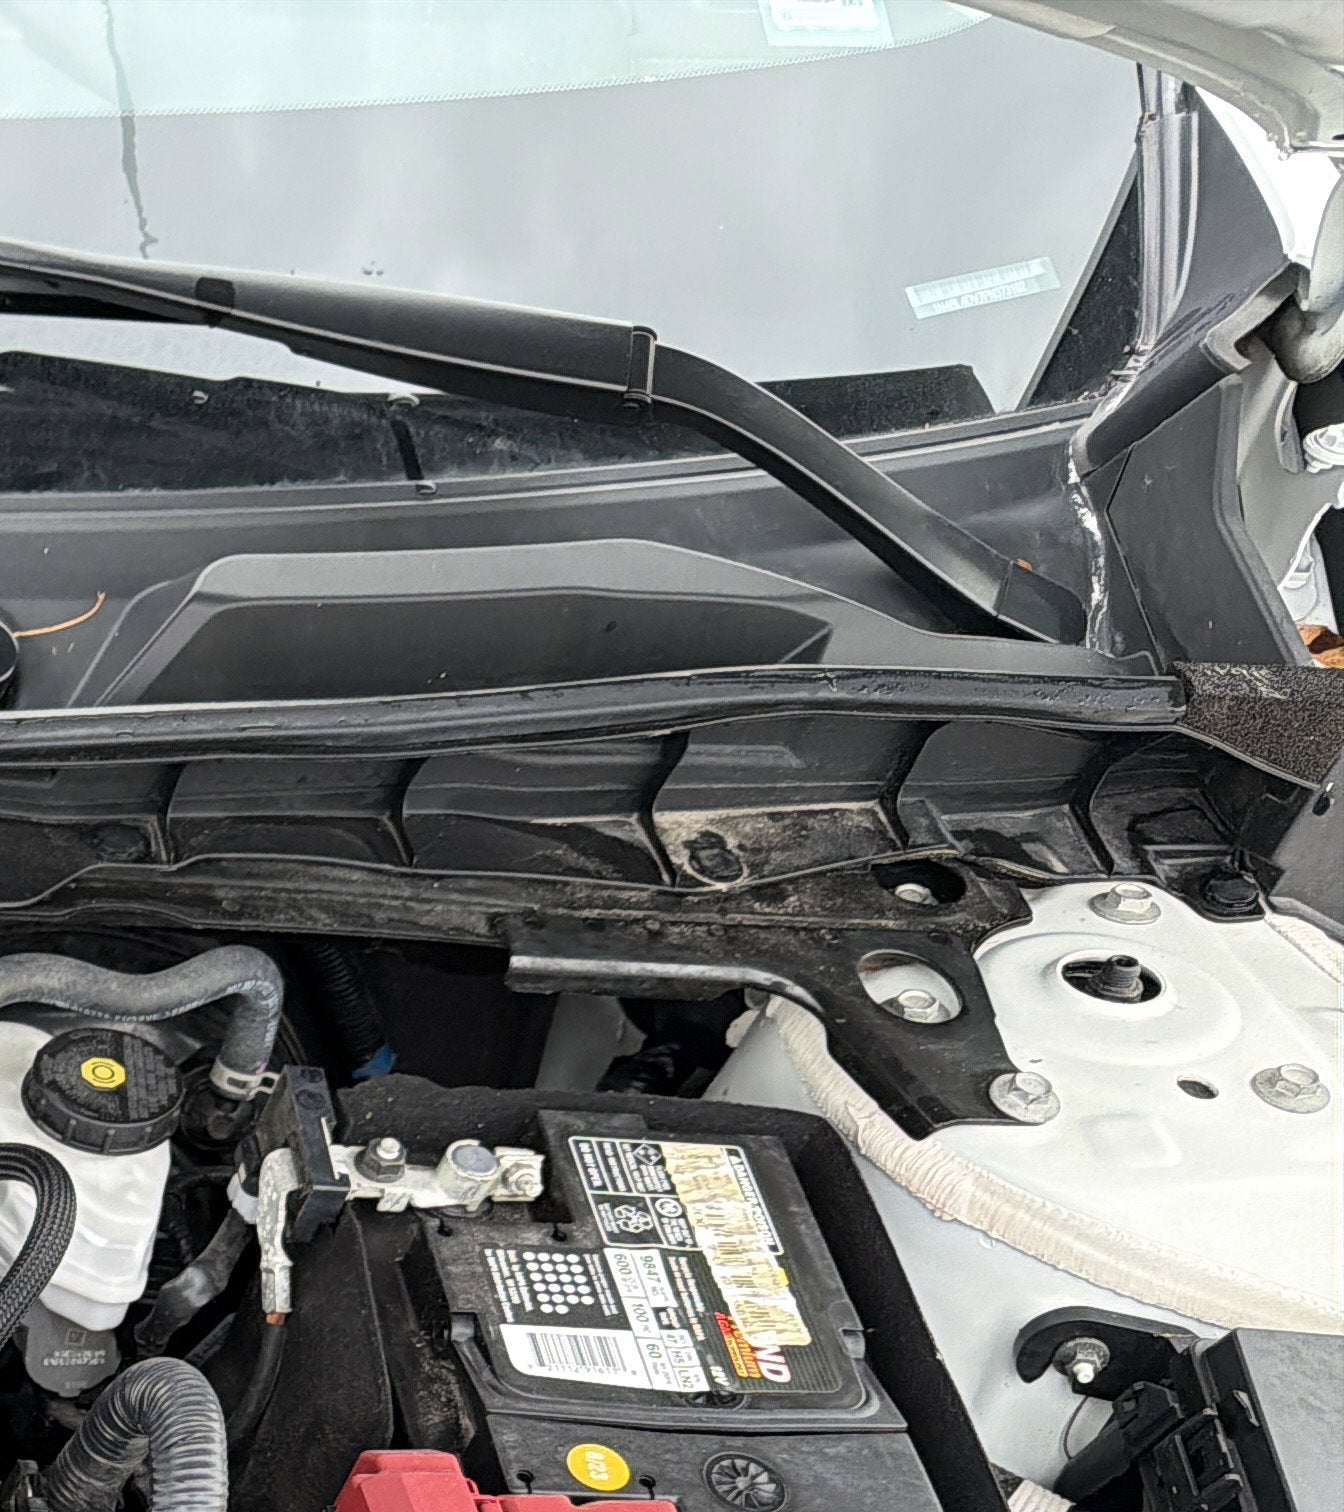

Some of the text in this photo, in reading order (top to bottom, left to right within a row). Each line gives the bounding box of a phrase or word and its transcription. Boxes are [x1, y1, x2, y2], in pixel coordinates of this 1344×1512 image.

[614, 1254, 632, 1275] 600
[641, 1256, 662, 1283] 9847
[633, 1303, 650, 1322] 100
[646, 1343, 662, 1359] 60
